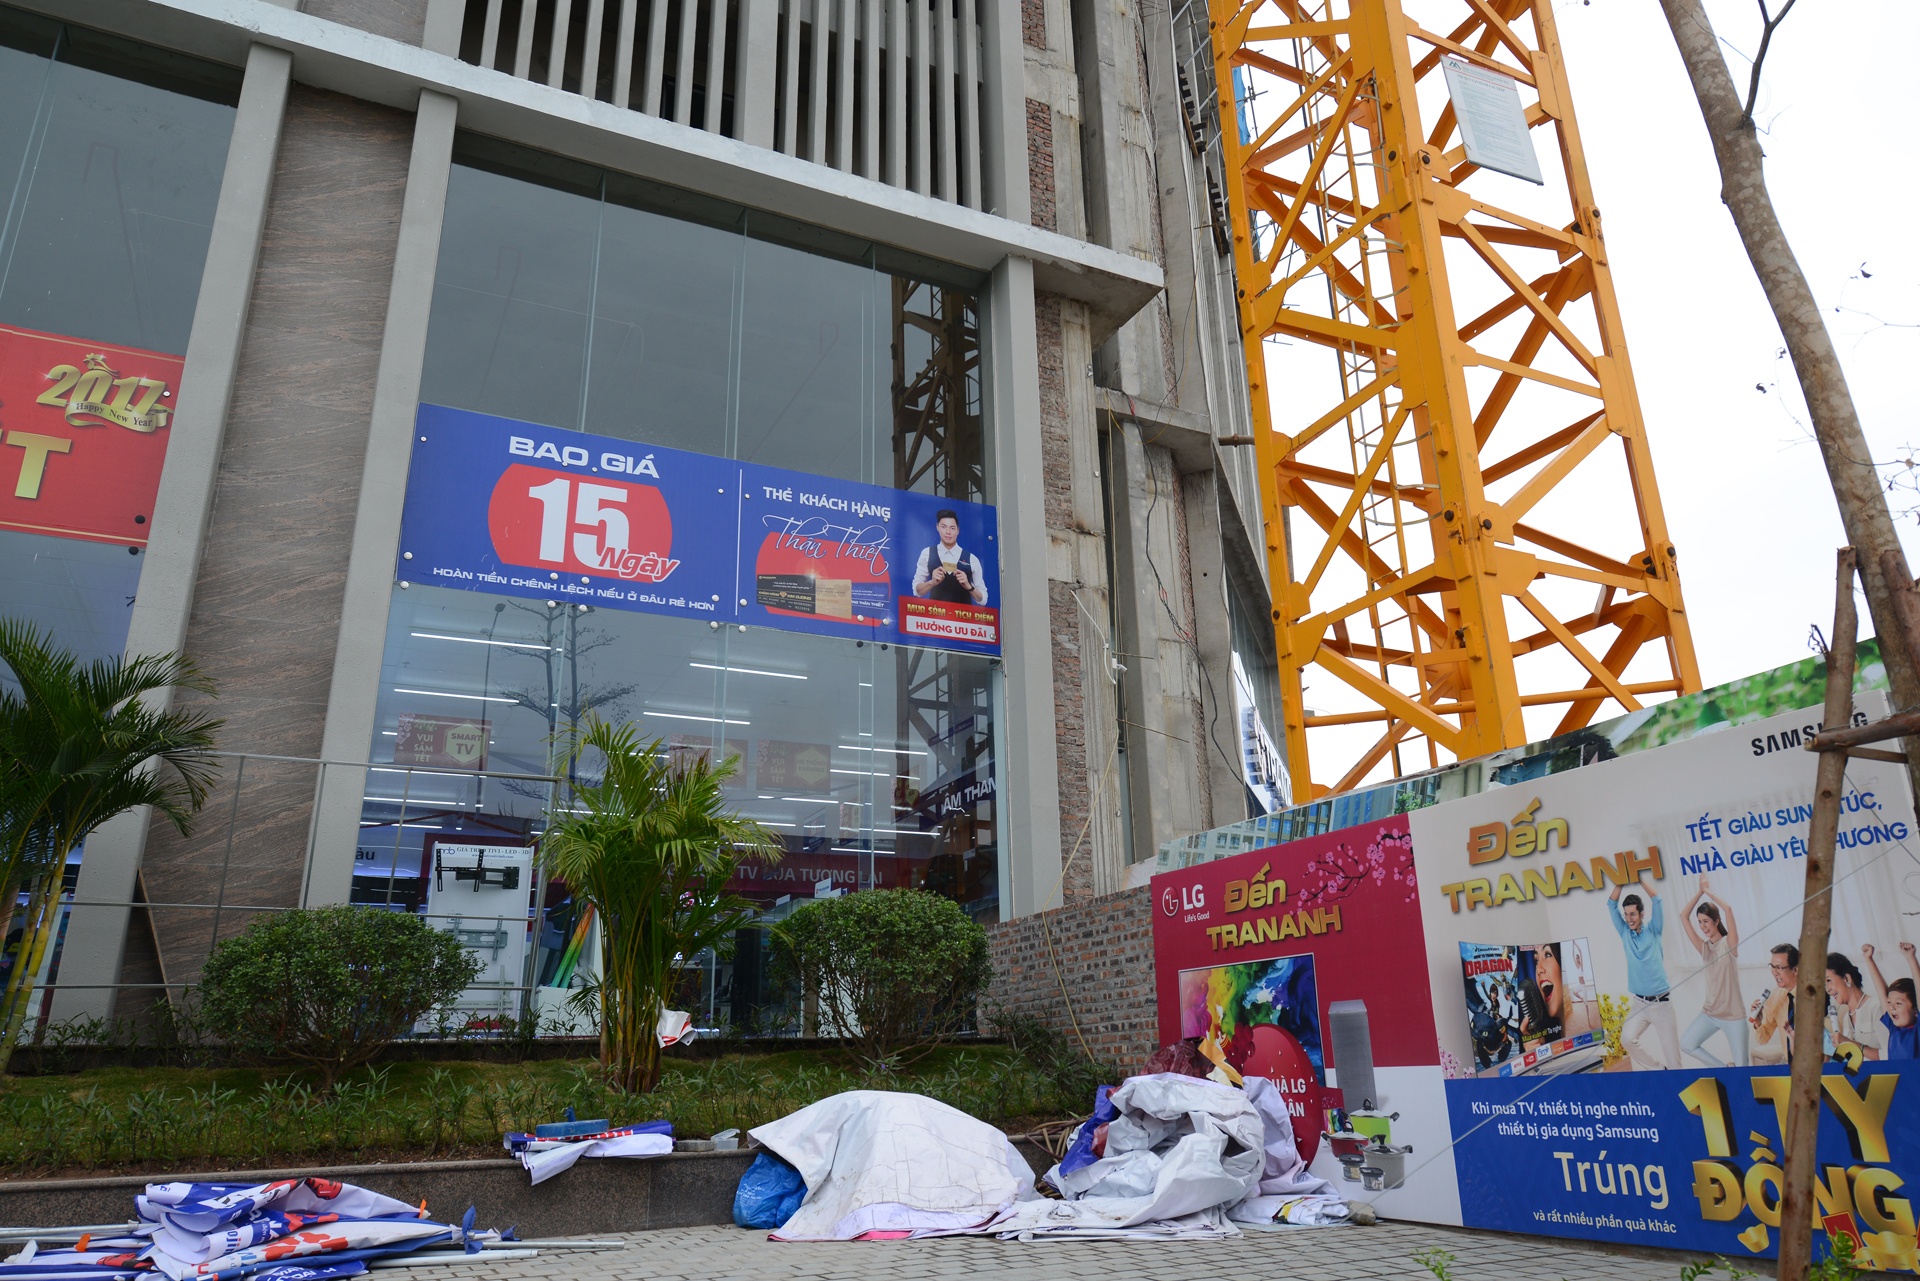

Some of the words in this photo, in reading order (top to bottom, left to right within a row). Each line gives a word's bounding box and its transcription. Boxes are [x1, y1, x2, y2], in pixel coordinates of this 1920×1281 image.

[36, 364, 166, 416] 2017
[75, 402, 105, 414] Happy
[109, 409, 129, 423] New
[133, 416, 153, 427] Year
[0, 430, 72, 500] T
[509, 435, 589, 467] BAO
[600, 453, 660, 479] GIÁ
[763, 486, 793, 503] THẺ
[799, 492, 848, 513] KHÁCH
[851, 501, 891, 520] HÀNG
[528, 477, 630, 570] 15
[597, 546, 681, 582] Ngày
[762, 514, 829, 560] Thân
[823, 524, 892, 577] Thiết
[433, 566, 476, 582] HOÀN
[476, 571, 508, 586] TIỀN
[511, 576, 558, 592] CHÊNH
[560, 583, 594, 598] LỆCH
[597, 586, 625, 601] NẾU
[627, 590, 639, 602] Ở
[639, 592, 667, 605] ĐÂU
[669, 596, 687, 608] RẺ
[689, 600, 716, 612] HƠN
[906, 603, 927, 615] MUA
[927, 602, 947, 617] SẮM
[955, 609, 973, 622] TÍCH
[974, 609, 996, 624] ĐIỂM
[915, 618, 955, 637] HƯỞNG
[955, 623, 969, 637] ƯU
[970, 623, 988, 639] ĐÃI
[416, 733, 434, 742] VUI
[450, 732, 482, 742] SMART
[456, 743, 474, 755] TV
[1751, 711, 1869, 757] SAMSG
[414, 752, 431, 762] TẾT
[942, 792, 962, 816] ÂM
[964, 777, 997, 803] THAN
[1467, 796, 1569, 866] Đến
[1686, 812, 1722, 843] TẾT
[1728, 811, 1772, 835] GIÀU
[1776, 803, 1812, 826] SUN
[1680, 846, 1728, 876] NHÀ
[1730, 844, 1774, 868] GIÀU
[1835, 821, 1909, 851] HƯƠNG
[737, 865, 759, 880] TV
[800, 867, 855, 884] TƯƠNG
[859, 871, 883, 885] LAI
[1224, 862, 1287, 914] Đến
[1440, 846, 1665, 914] TRANANH
[1182, 884, 1205, 911] LG
[1184, 913, 1198, 923] Life's
[1197, 911, 1210, 923] Good
[1206, 905, 1342, 950] TRANANH
[1464, 957, 1514, 978] DRAGON
[1271, 1075, 1289, 1094] UÀ
[1290, 1078, 1306, 1094] LG
[1678, 1077, 1739, 1157] 1
[1750, 1041, 1900, 1163] TỶ
[1472, 1101, 1490, 1114] Khi
[1492, 1104, 1516, 1115] mua
[1517, 1102, 1537, 1117] TV,
[1539, 1100, 1569, 1115] thiết
[1571, 1101, 1583, 1118] bị
[1585, 1104, 1618, 1119] nghe
[1620, 1101, 1656, 1118] nhìn,
[1498, 1121, 1525, 1136] thiết
[1527, 1123, 1539, 1139] bị
[1541, 1125, 1559, 1140] gia
[1561, 1123, 1594, 1141] dụng
[1597, 1124, 1660, 1143] Samsung
[1553, 1150, 1670, 1210] Trúng
[1692, 1130, 1917, 1237] ĐỒNG
[1533, 1210, 1545, 1221] và
[1547, 1209, 1562, 1223] rất
[1563, 1212, 1593, 1226] nhiều
[1595, 1213, 1623, 1229] phần
[1625, 1218, 1647, 1233] quà
[1648, 1219, 1677, 1234] khác
